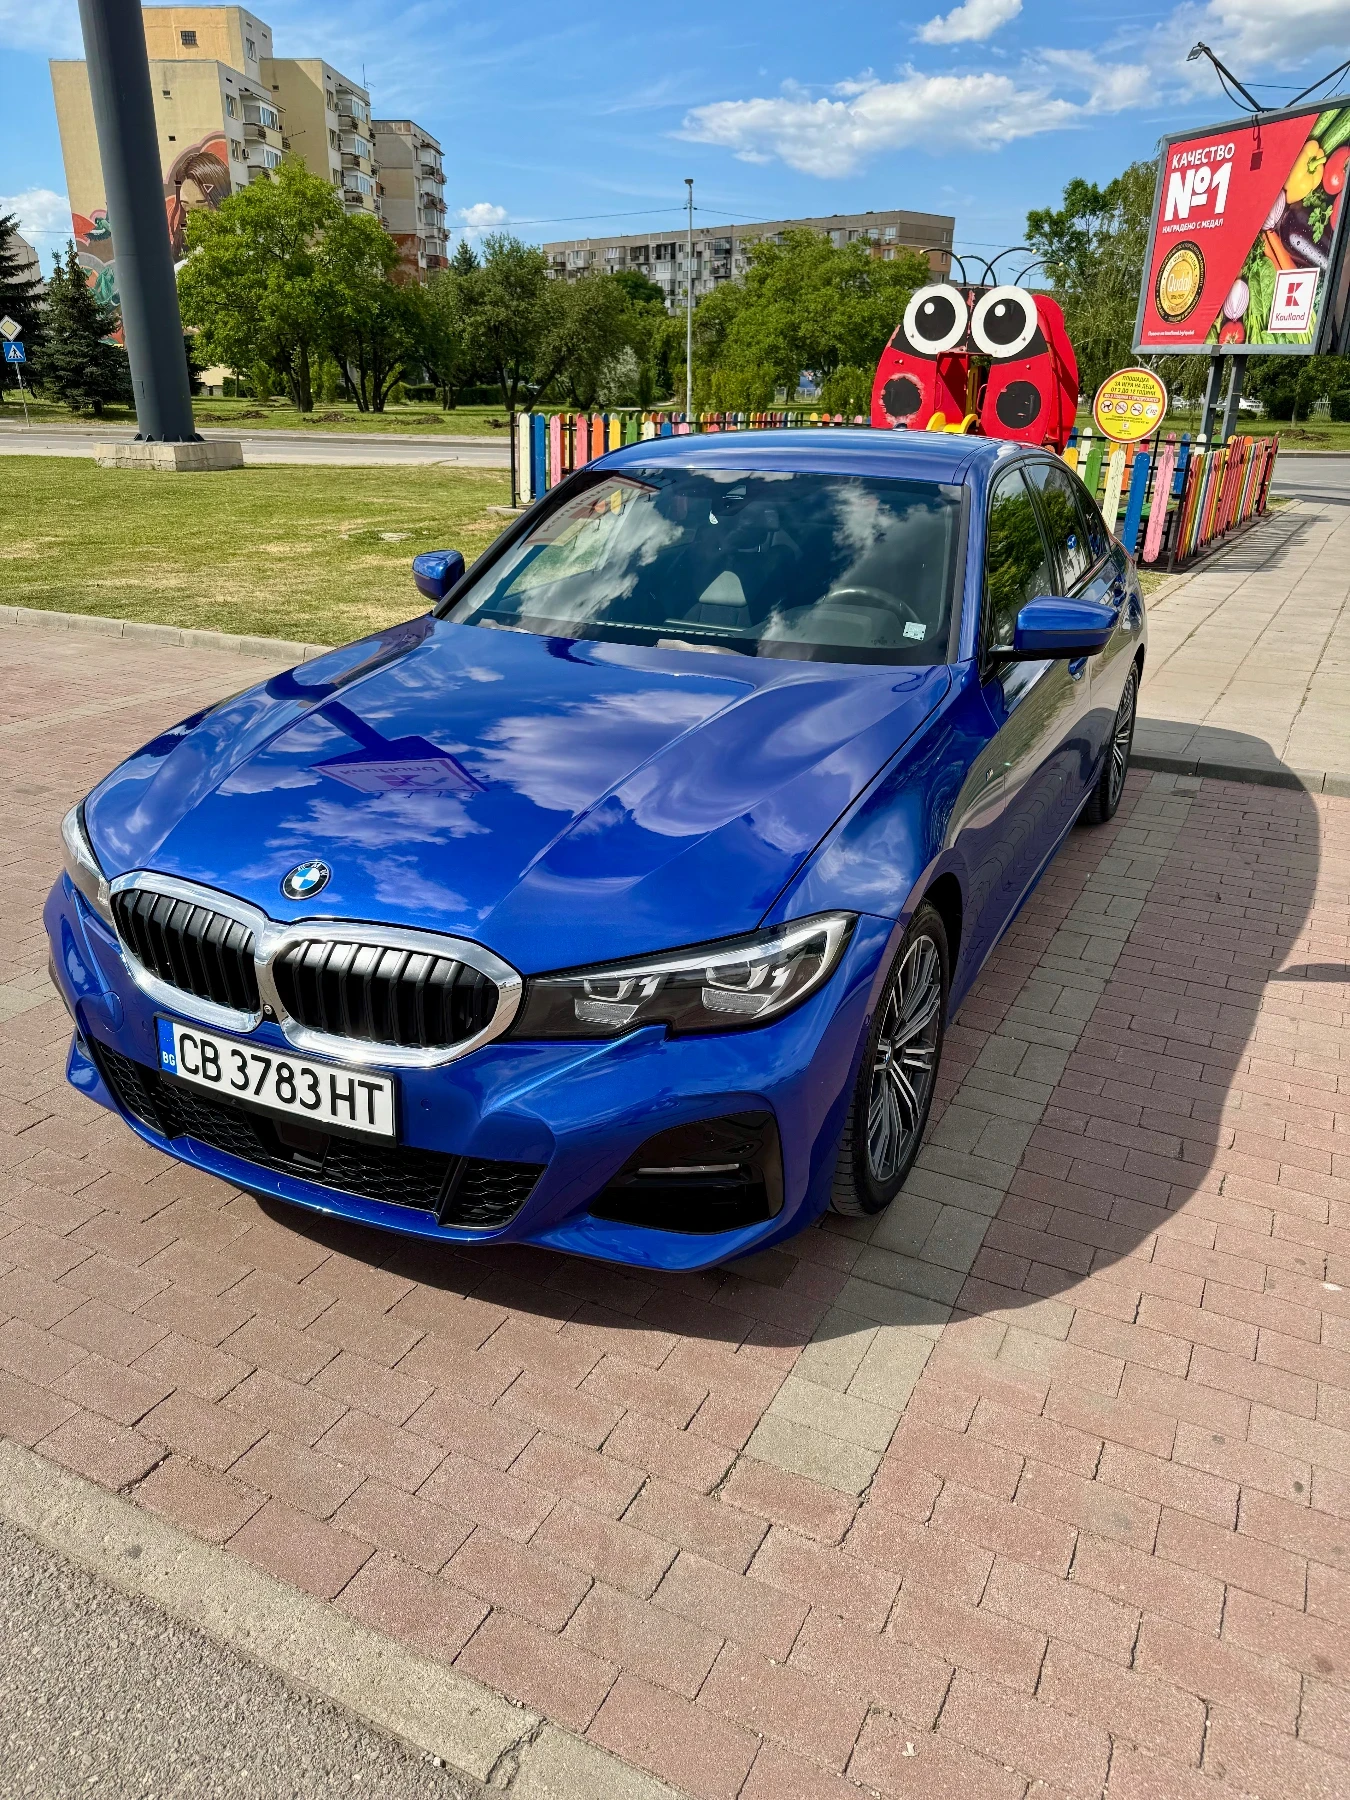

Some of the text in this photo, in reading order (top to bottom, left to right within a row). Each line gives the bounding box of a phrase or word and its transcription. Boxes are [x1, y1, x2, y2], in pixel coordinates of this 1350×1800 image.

[1172, 142, 1235, 170] КАЧЕСТВО
[1162, 222, 1196, 234] НАГРАДЕНО
[1201, 218, 1224, 229] МЕДАЛ
[1275, 312, 1306, 322] Kaufland
[162, 1050, 176, 1066] BG
[179, 1032, 384, 1125] CB 3783 HT
